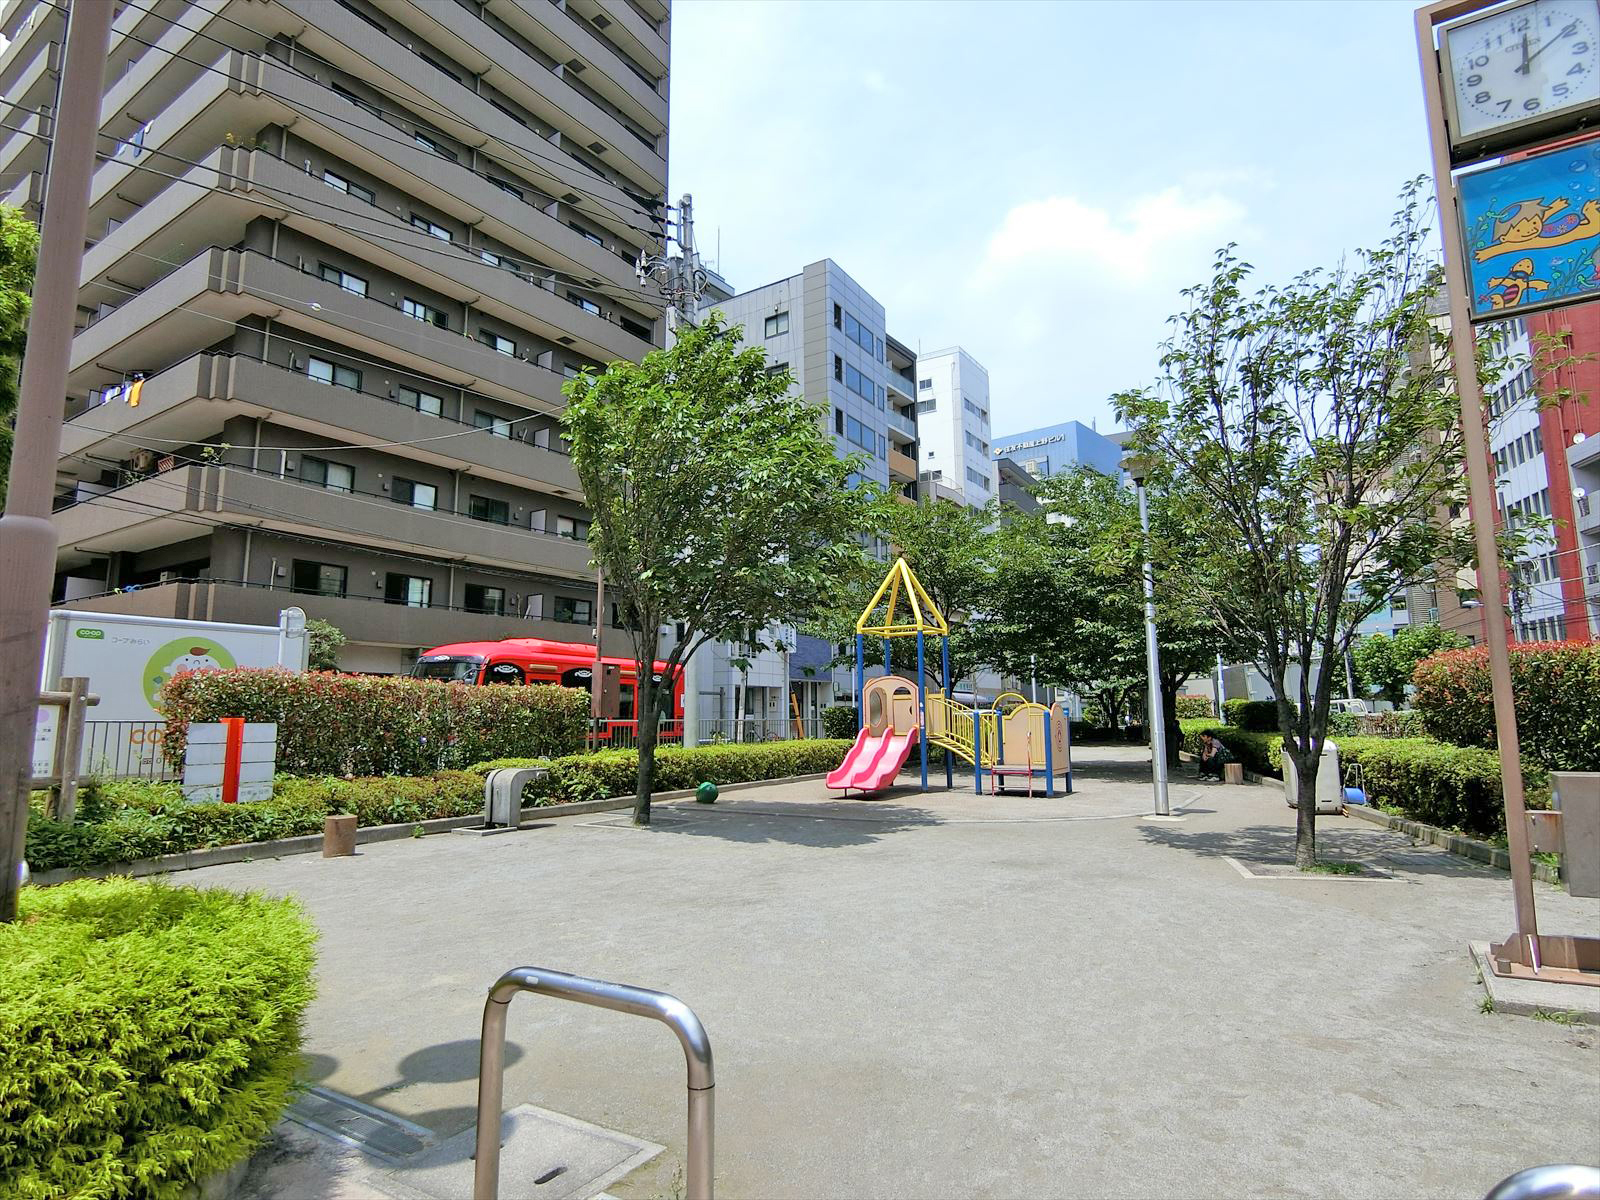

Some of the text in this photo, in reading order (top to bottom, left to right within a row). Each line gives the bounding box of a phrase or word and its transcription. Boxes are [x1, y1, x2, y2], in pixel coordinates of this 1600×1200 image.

[1510, 18, 1530, 35] 12
[1544, 15, 1551, 28] 1
[1561, 23, 1578, 39] 2
[1484, 35, 1503, 49] 11
[1572, 41, 1589, 55] 3
[1468, 55, 1489, 71] 10
[1566, 62, 1585, 76] 4
[1466, 74, 1483, 87] 9
[1552, 82, 1569, 97] 5
[1475, 91, 1491, 104] 8
[1523, 97, 1541, 111] 6
[1496, 99, 1512, 113] 7
